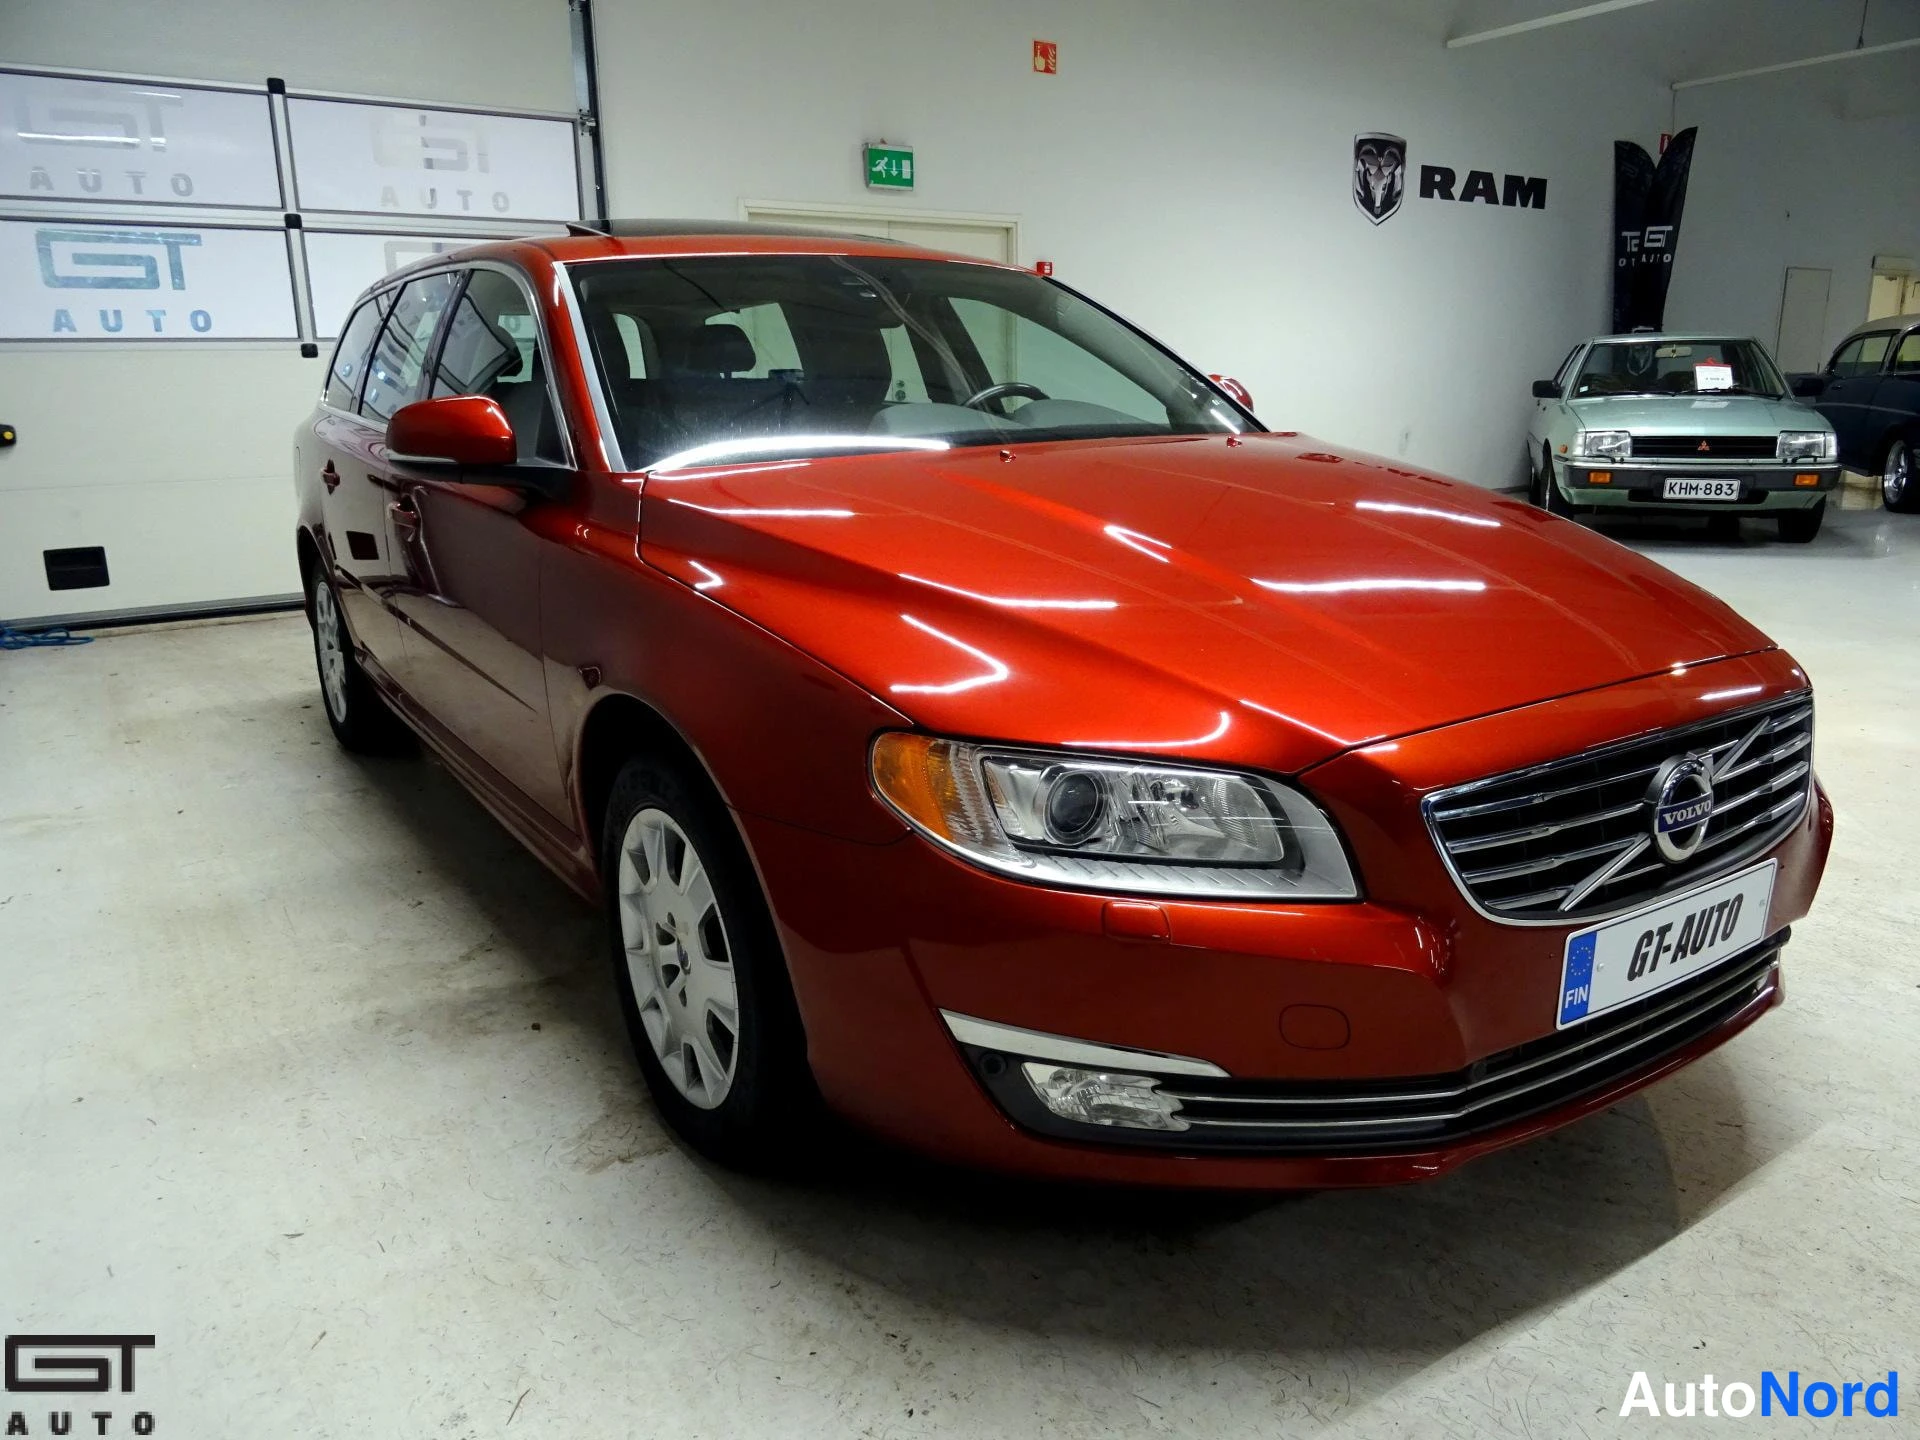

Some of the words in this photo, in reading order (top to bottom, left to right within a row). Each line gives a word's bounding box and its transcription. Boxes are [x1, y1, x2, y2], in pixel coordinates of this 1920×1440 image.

[29, 166, 194, 197] AUTO
[1419, 165, 1548, 210] RAM
[379, 185, 510, 212] AUTO
[53, 309, 212, 332] AUTO
[1668, 482, 1734, 496] KHM-883
[1662, 800, 1711, 825] VOLVO
[1627, 893, 1744, 982] GT-AUTO
[1565, 984, 1589, 1009] FIN
